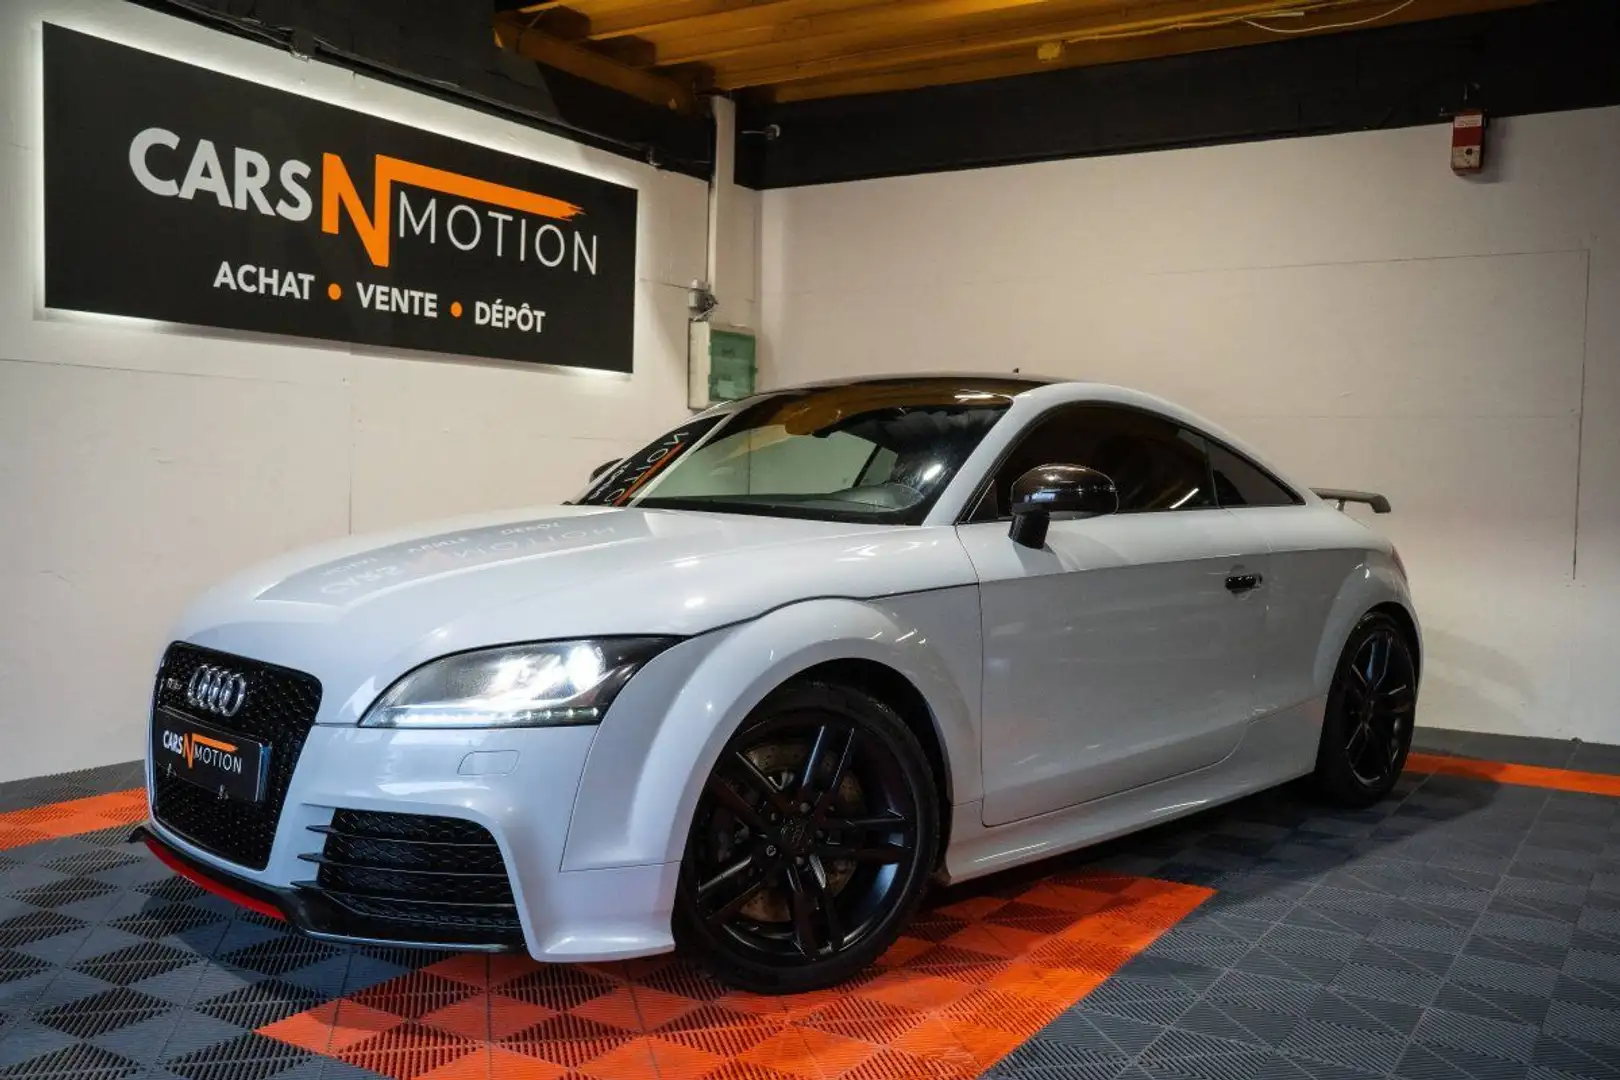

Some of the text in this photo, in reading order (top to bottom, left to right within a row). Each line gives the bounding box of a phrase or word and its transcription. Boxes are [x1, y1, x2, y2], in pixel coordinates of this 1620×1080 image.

[128, 127, 313, 222] CARS
[399, 190, 597, 276] MOTION
[212, 260, 546, 334] ACHAT VENTE DÉPÔT
[163, 729, 184, 755] CARS
[194, 743, 243, 775] MOTION
